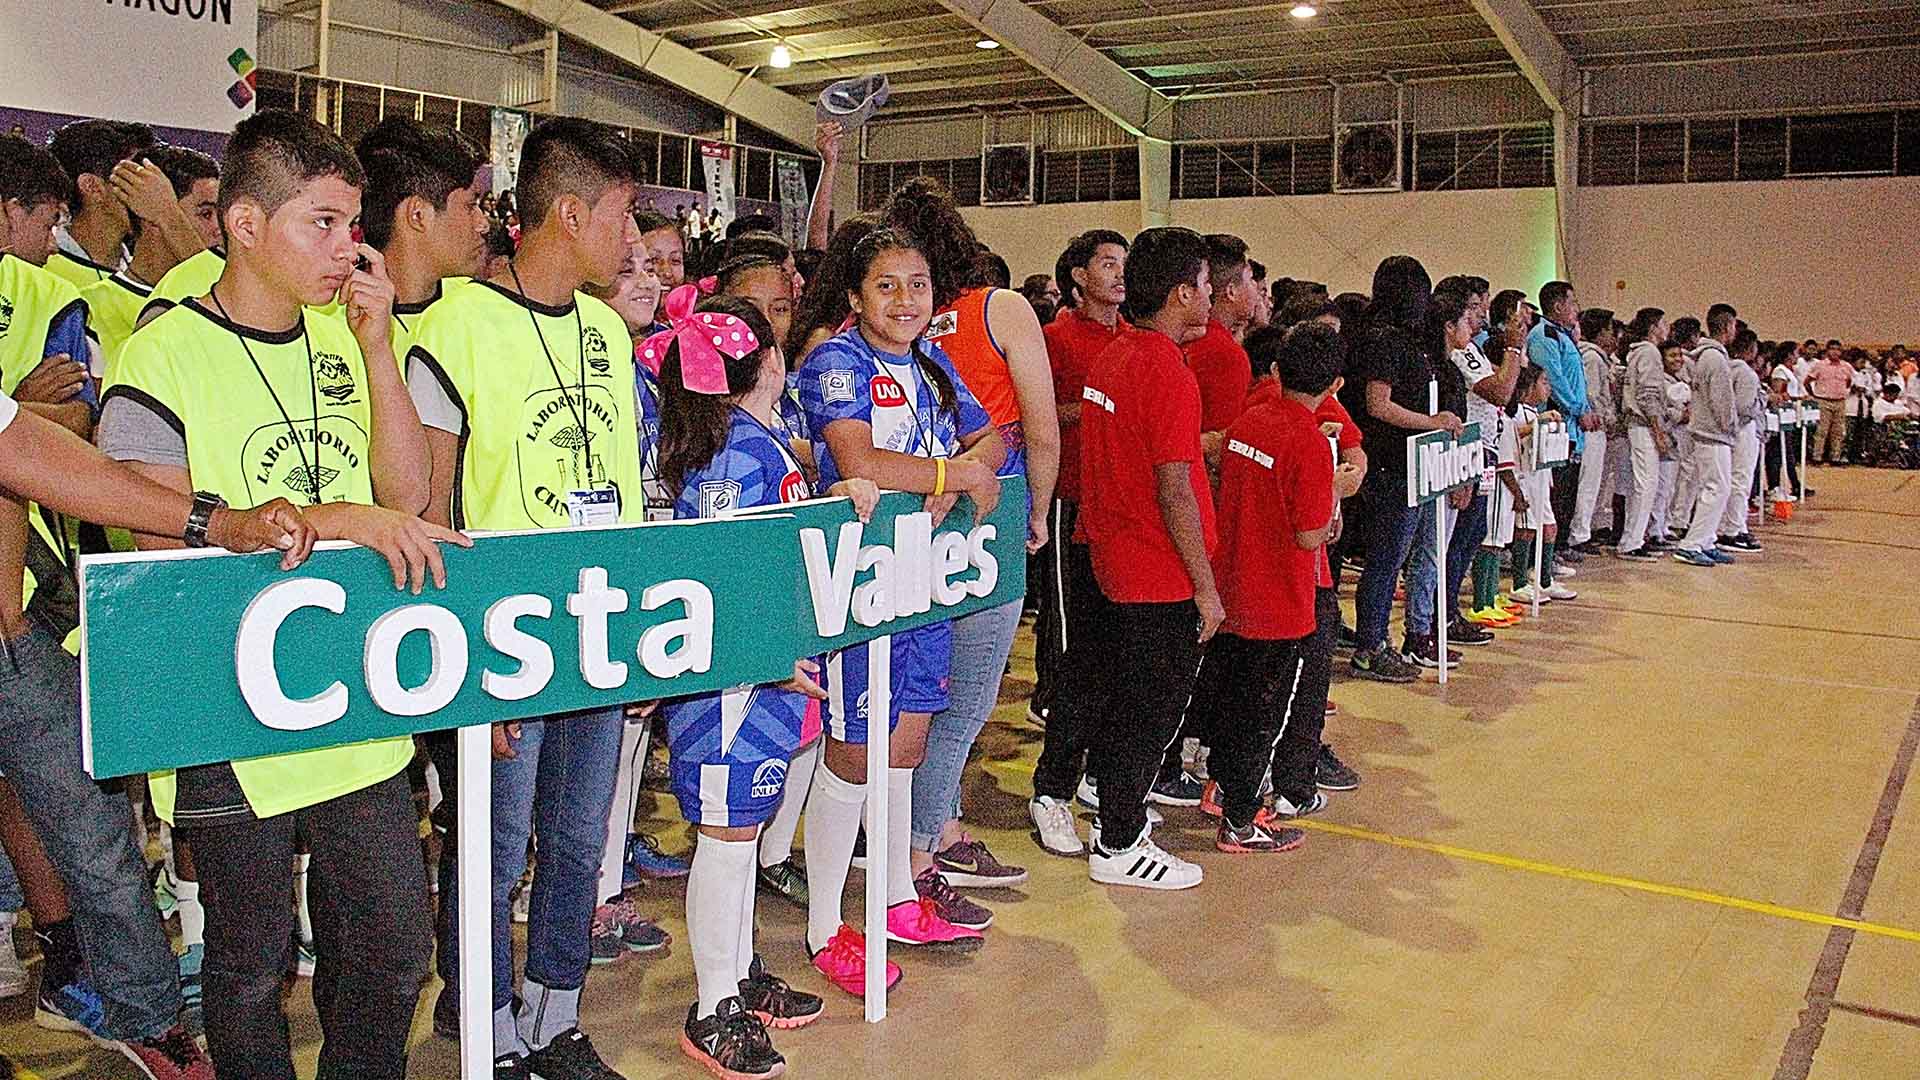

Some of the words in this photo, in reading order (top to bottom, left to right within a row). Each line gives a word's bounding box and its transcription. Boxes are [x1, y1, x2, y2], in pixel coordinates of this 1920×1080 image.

[256, 428, 359, 485] LABORATORIO
[235, 566, 714, 731] Costa
[799, 511, 999, 638] Valles
